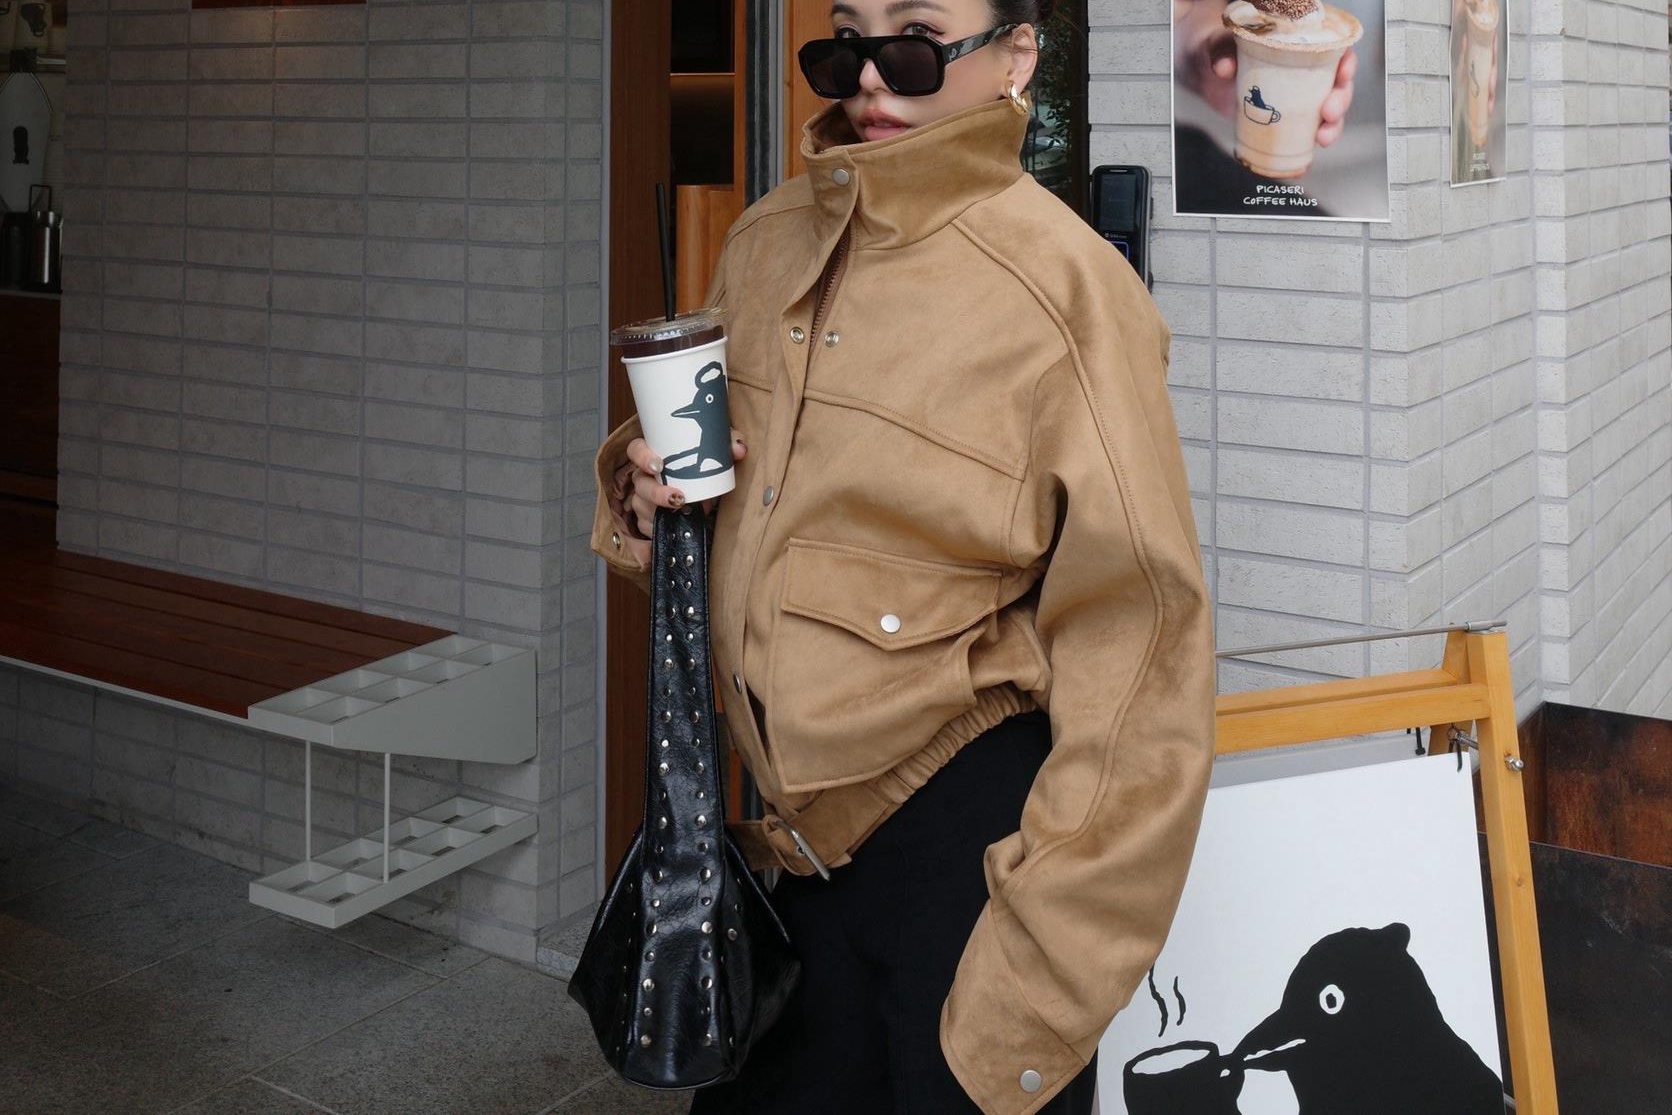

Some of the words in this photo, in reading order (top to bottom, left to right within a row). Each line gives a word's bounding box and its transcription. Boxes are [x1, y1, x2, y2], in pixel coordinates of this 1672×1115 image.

[1256, 185, 1305, 195] PICASERI
[1243, 197, 1286, 206] COFFEE
[1289, 197, 1318, 207] HAUS
